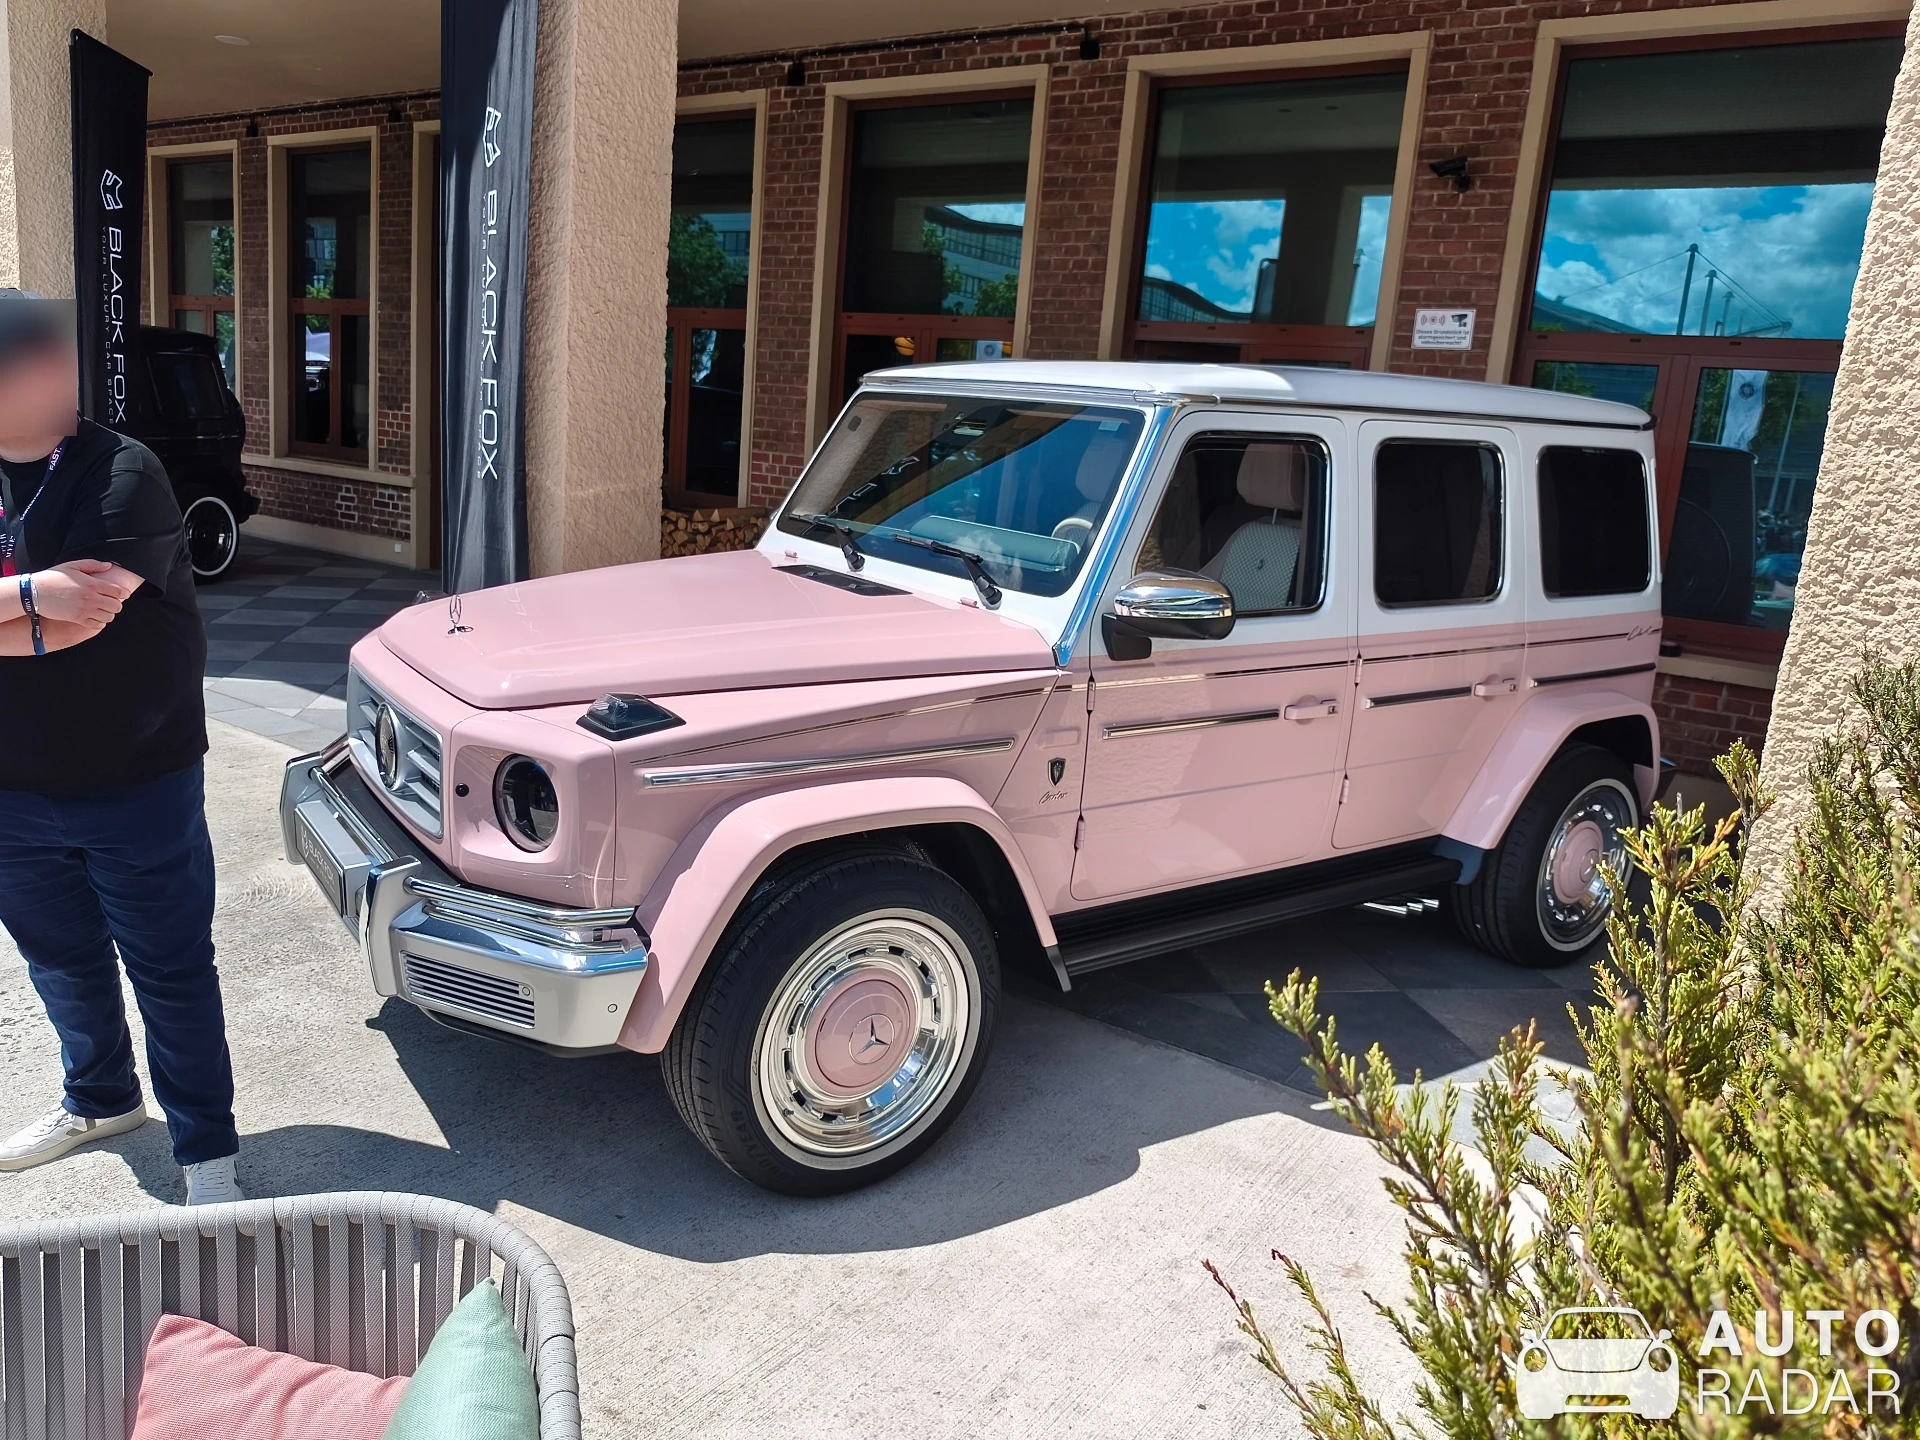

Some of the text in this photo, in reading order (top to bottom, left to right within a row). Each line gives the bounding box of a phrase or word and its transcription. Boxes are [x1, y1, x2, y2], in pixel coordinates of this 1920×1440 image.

[102, 273, 110, 332] LUXURY
[108, 226, 126, 423] BLACK FOX
[480, 189, 497, 480] BLACK FOX
[49, 446, 63, 470] FAST.
